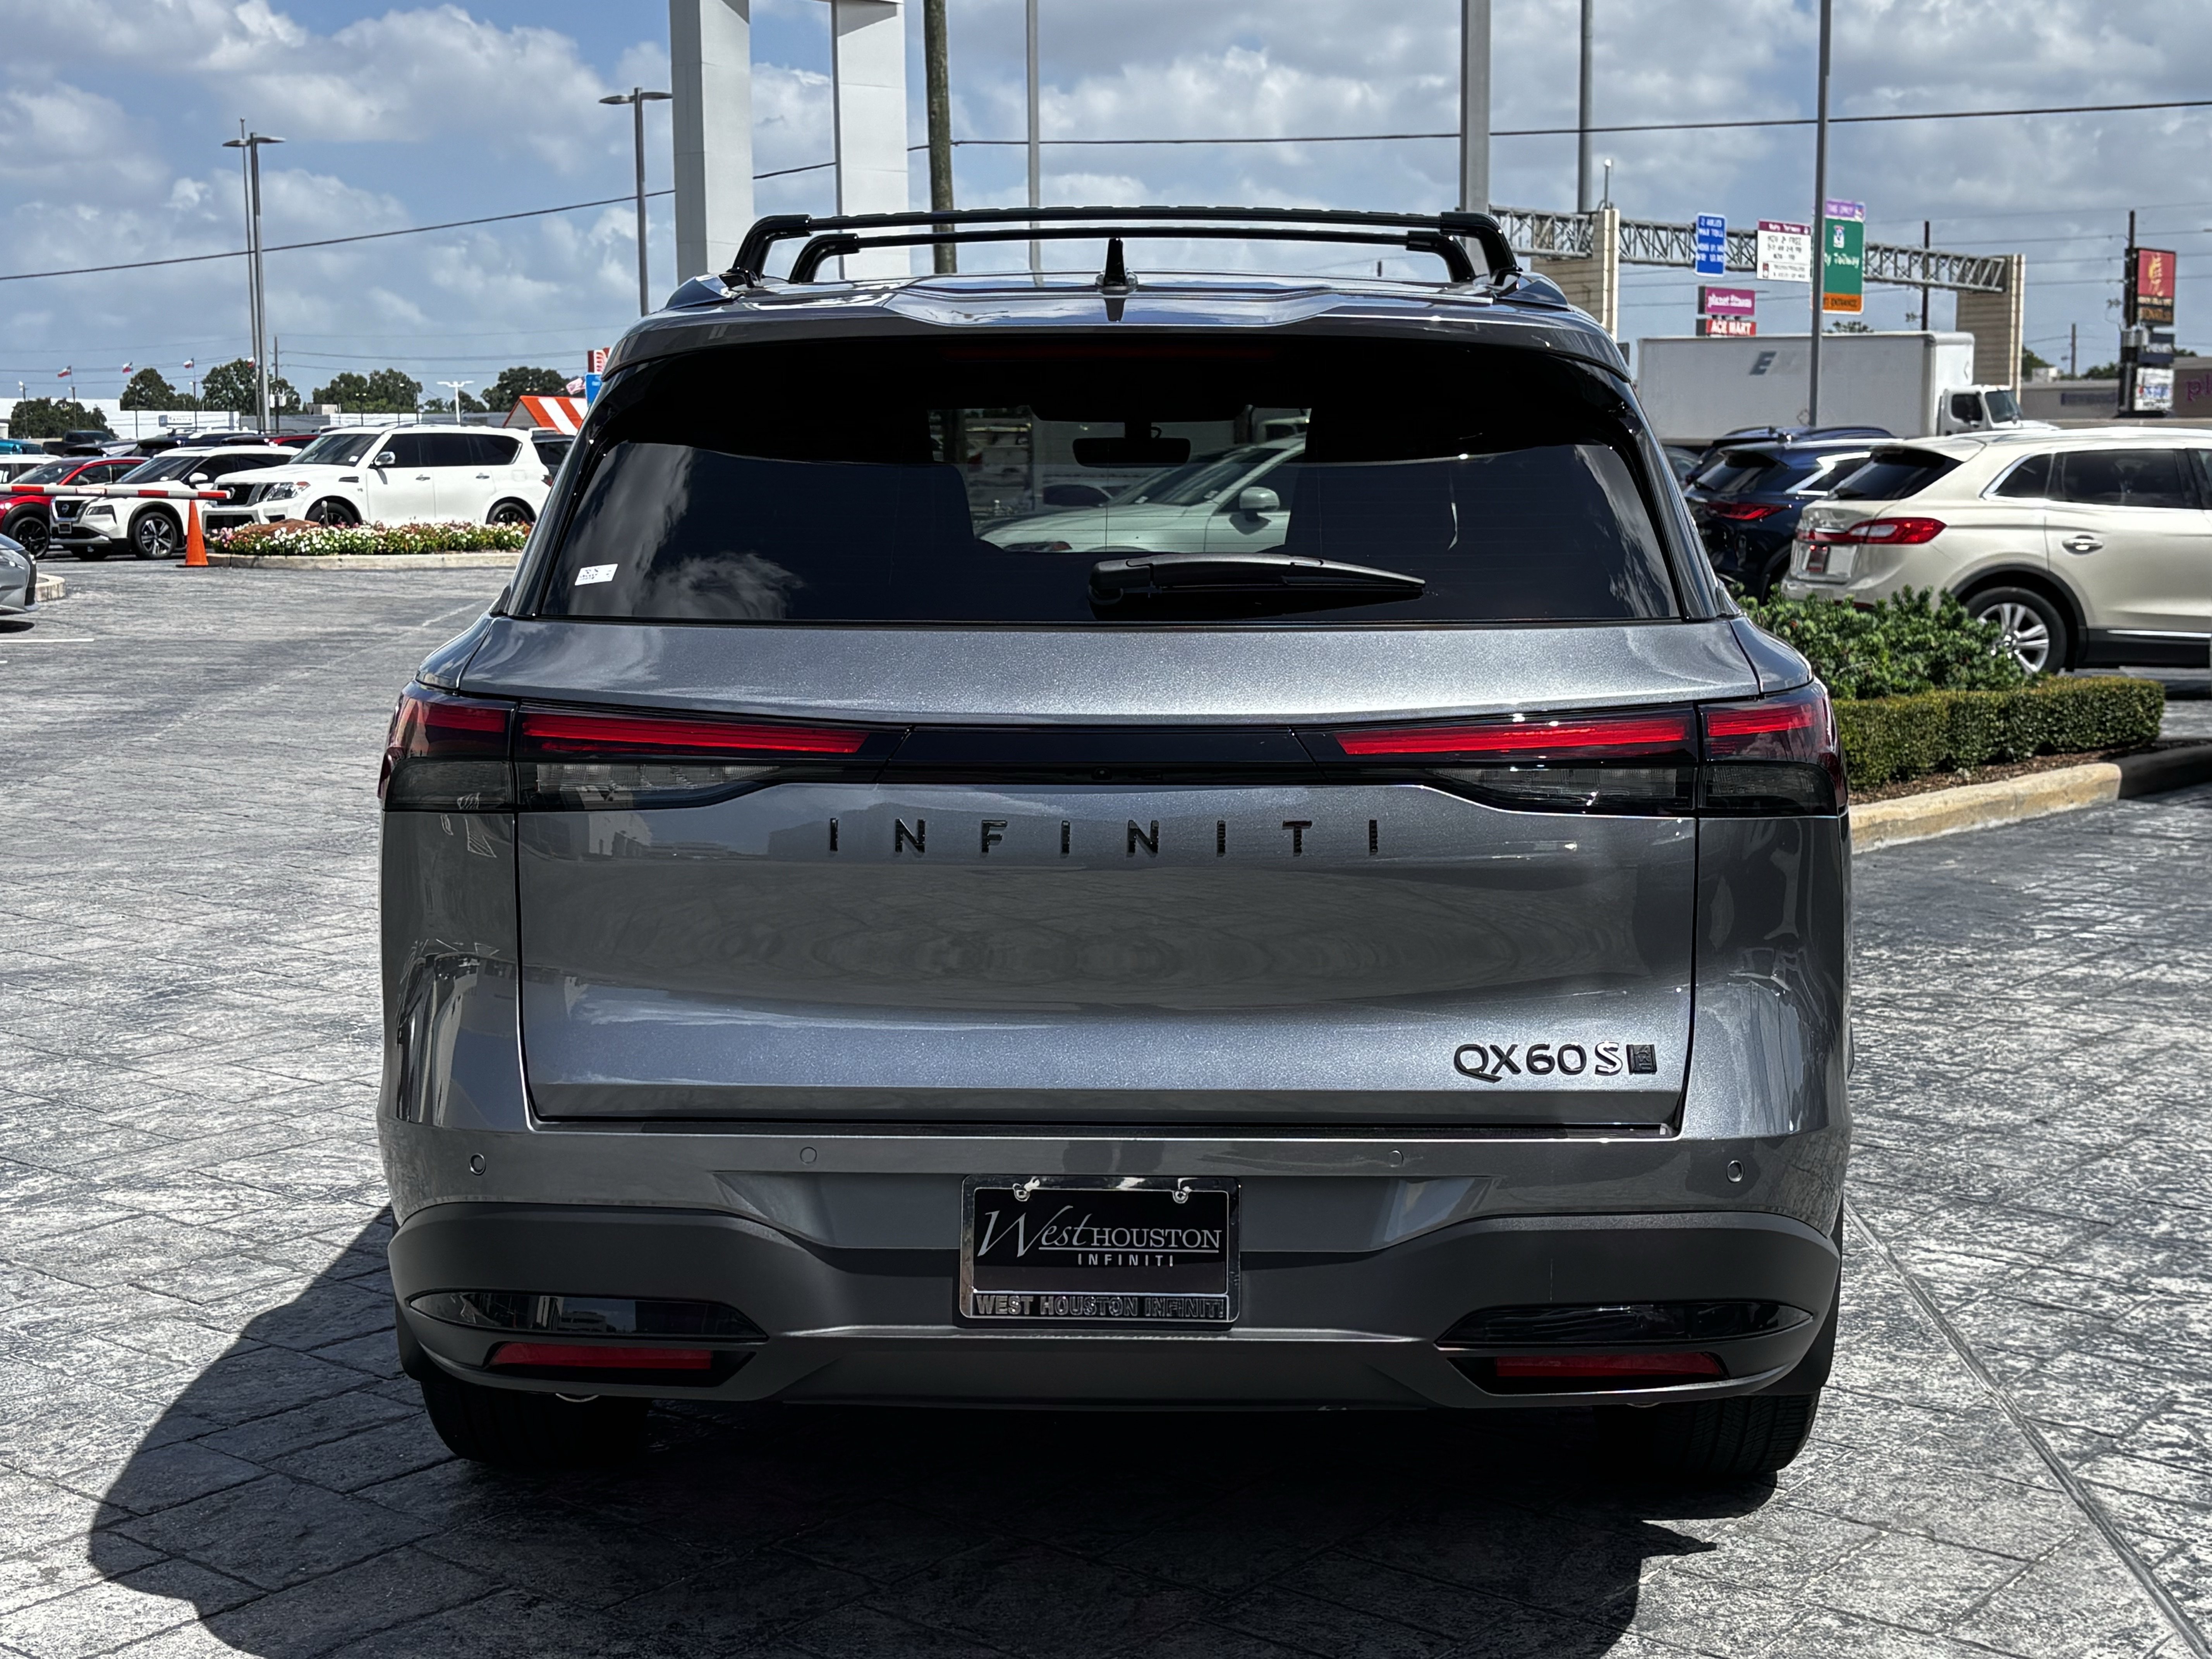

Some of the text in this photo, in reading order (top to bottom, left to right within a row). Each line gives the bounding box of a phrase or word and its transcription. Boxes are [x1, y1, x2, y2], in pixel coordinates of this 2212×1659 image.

[830, 817, 1378, 857] INFINITI
[977, 1205, 1222, 1257] West HOUSTON
[1078, 1253, 1173, 1267] INFINITI
[976, 1295, 1224, 1318] WEST HOUSTON INFINITI
